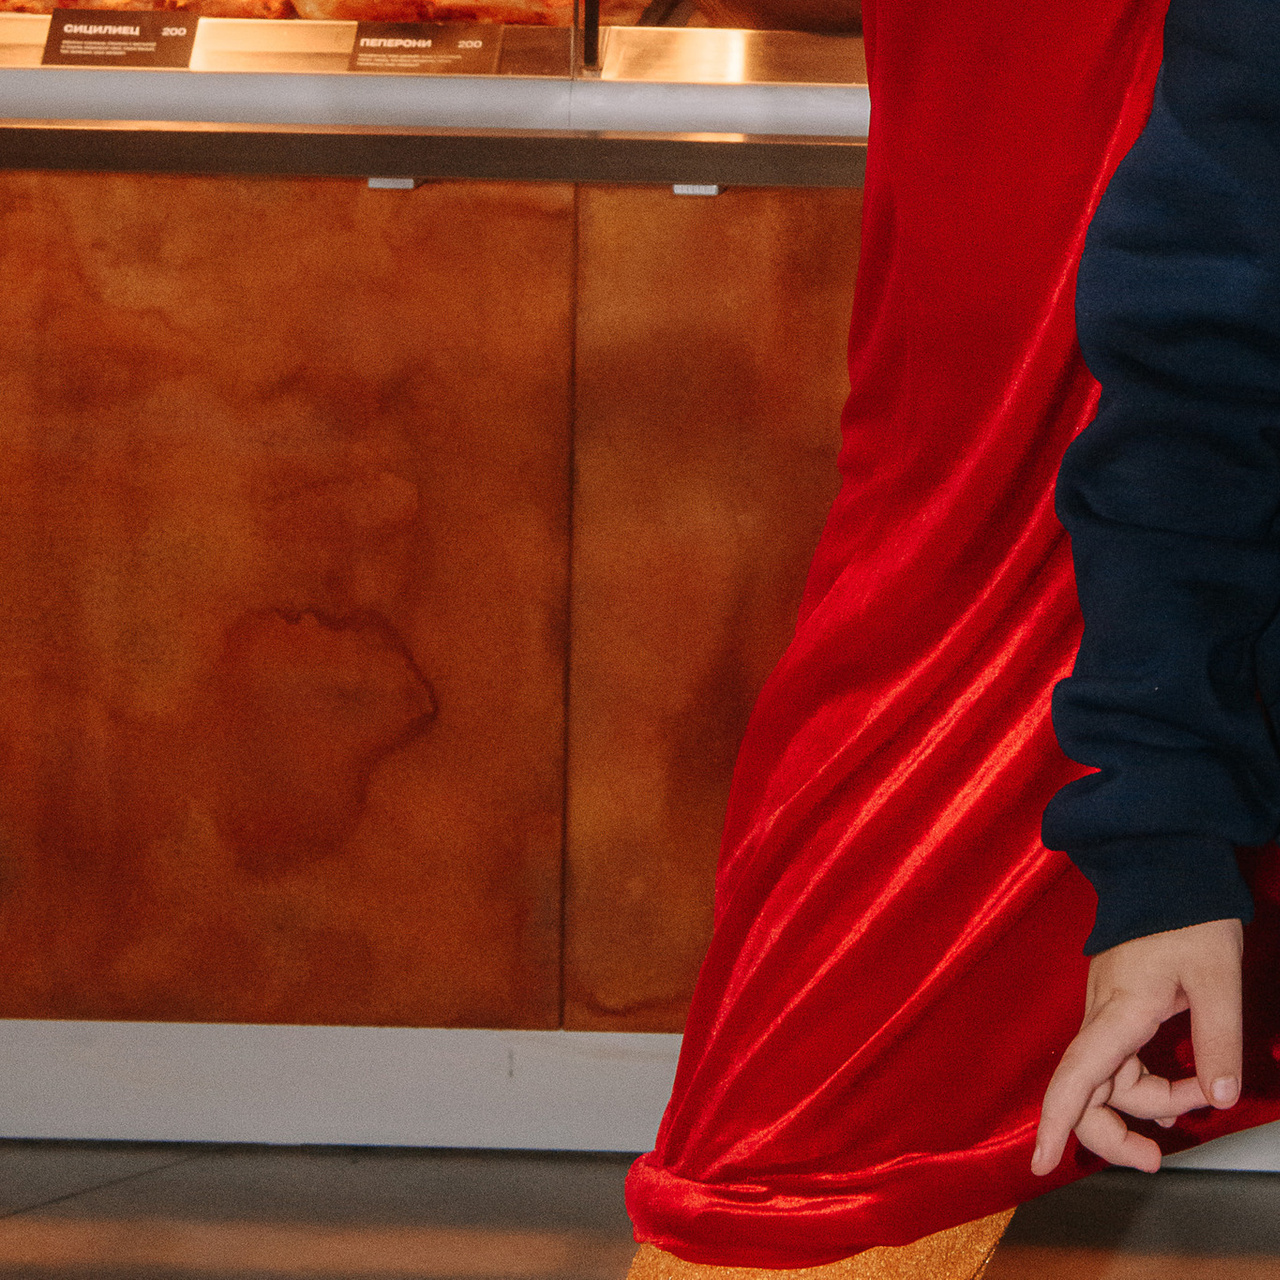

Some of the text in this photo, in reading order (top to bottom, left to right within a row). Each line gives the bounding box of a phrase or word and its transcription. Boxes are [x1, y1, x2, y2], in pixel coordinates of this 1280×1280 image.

[63, 23, 187, 37] СИЦИЛИЕЦ 200
[359, 38, 483, 49] ПЕПЕРОНИ 200
